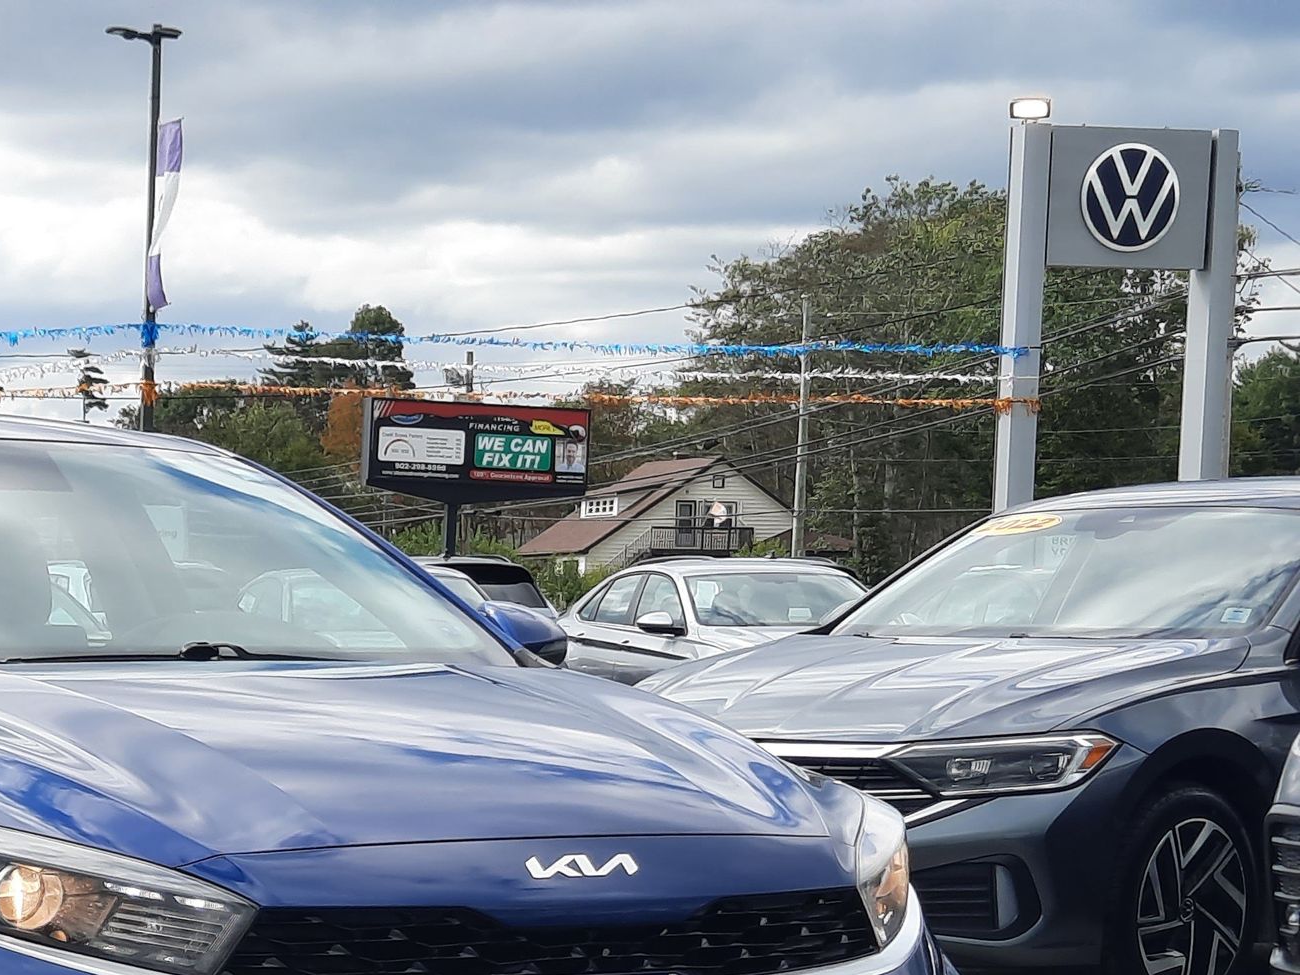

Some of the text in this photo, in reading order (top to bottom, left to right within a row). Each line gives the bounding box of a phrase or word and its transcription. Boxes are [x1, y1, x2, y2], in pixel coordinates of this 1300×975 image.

[468, 422, 520, 432] FINANCING
[477, 436, 506, 452] WE
[510, 438, 548, 454] CAN
[481, 452, 541, 469] FIX IT!
[525, 853, 639, 879] KIA
